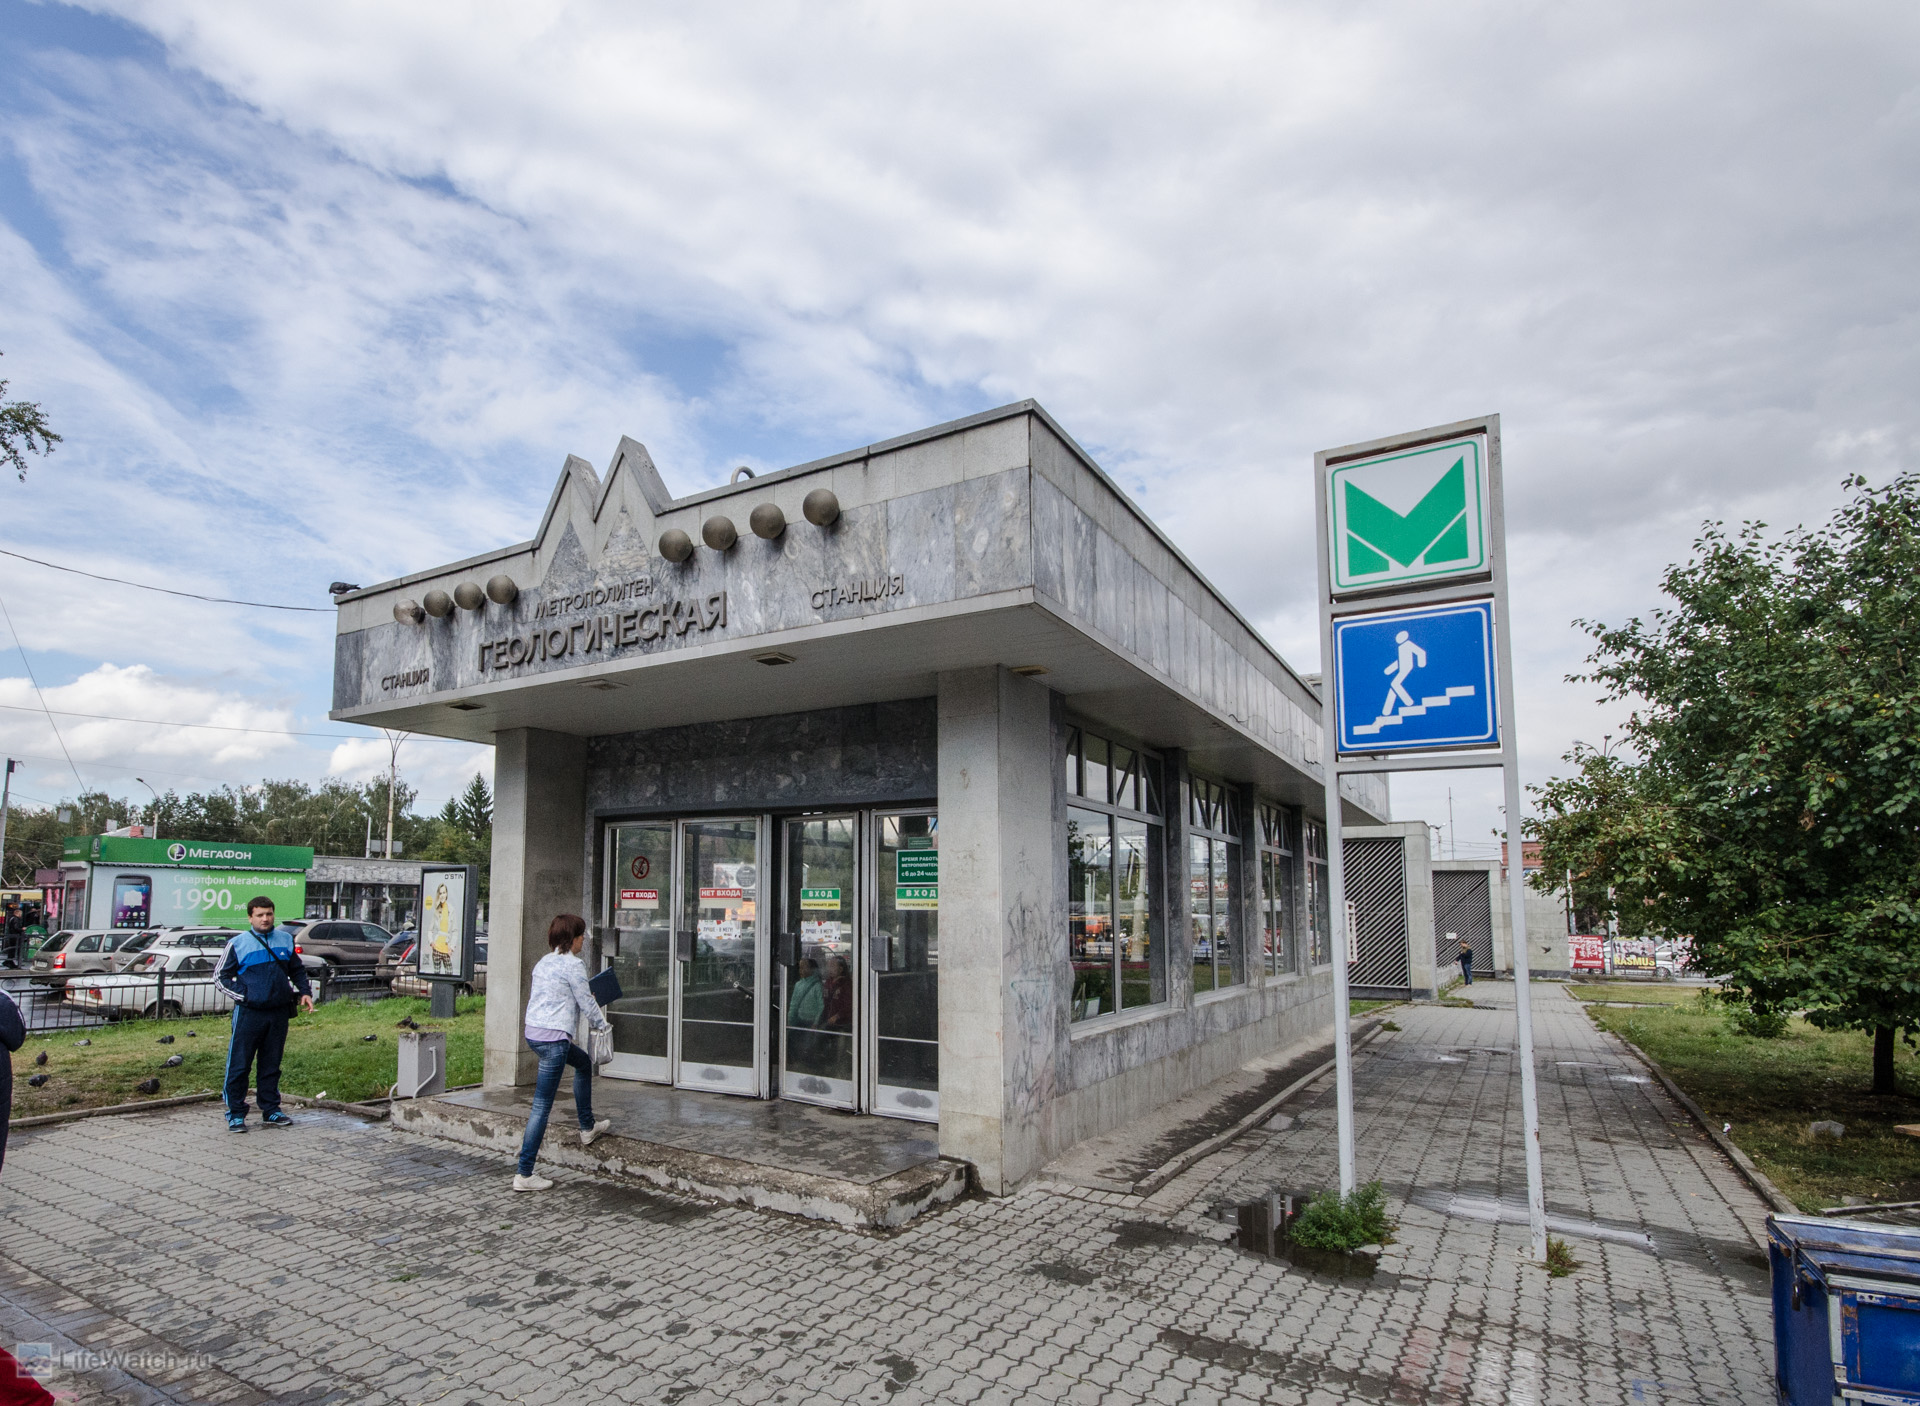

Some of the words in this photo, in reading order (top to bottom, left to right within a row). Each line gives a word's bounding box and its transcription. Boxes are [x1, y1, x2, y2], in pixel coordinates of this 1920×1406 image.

[534, 576, 654, 619] МЕТРОПОЛИТЕН
[810, 573, 905, 610] СТАНЦИЯ
[477, 590, 728, 672] ГЕОЛОГИЧЕСКАЯ
[380, 666, 430, 692] СТАНЦИЯ
[173, 874, 225, 887] Смартфон
[172, 888, 233, 911] 1990
[808, 890, 833, 898] ВХОД
[906, 889, 936, 897] ВХОД
